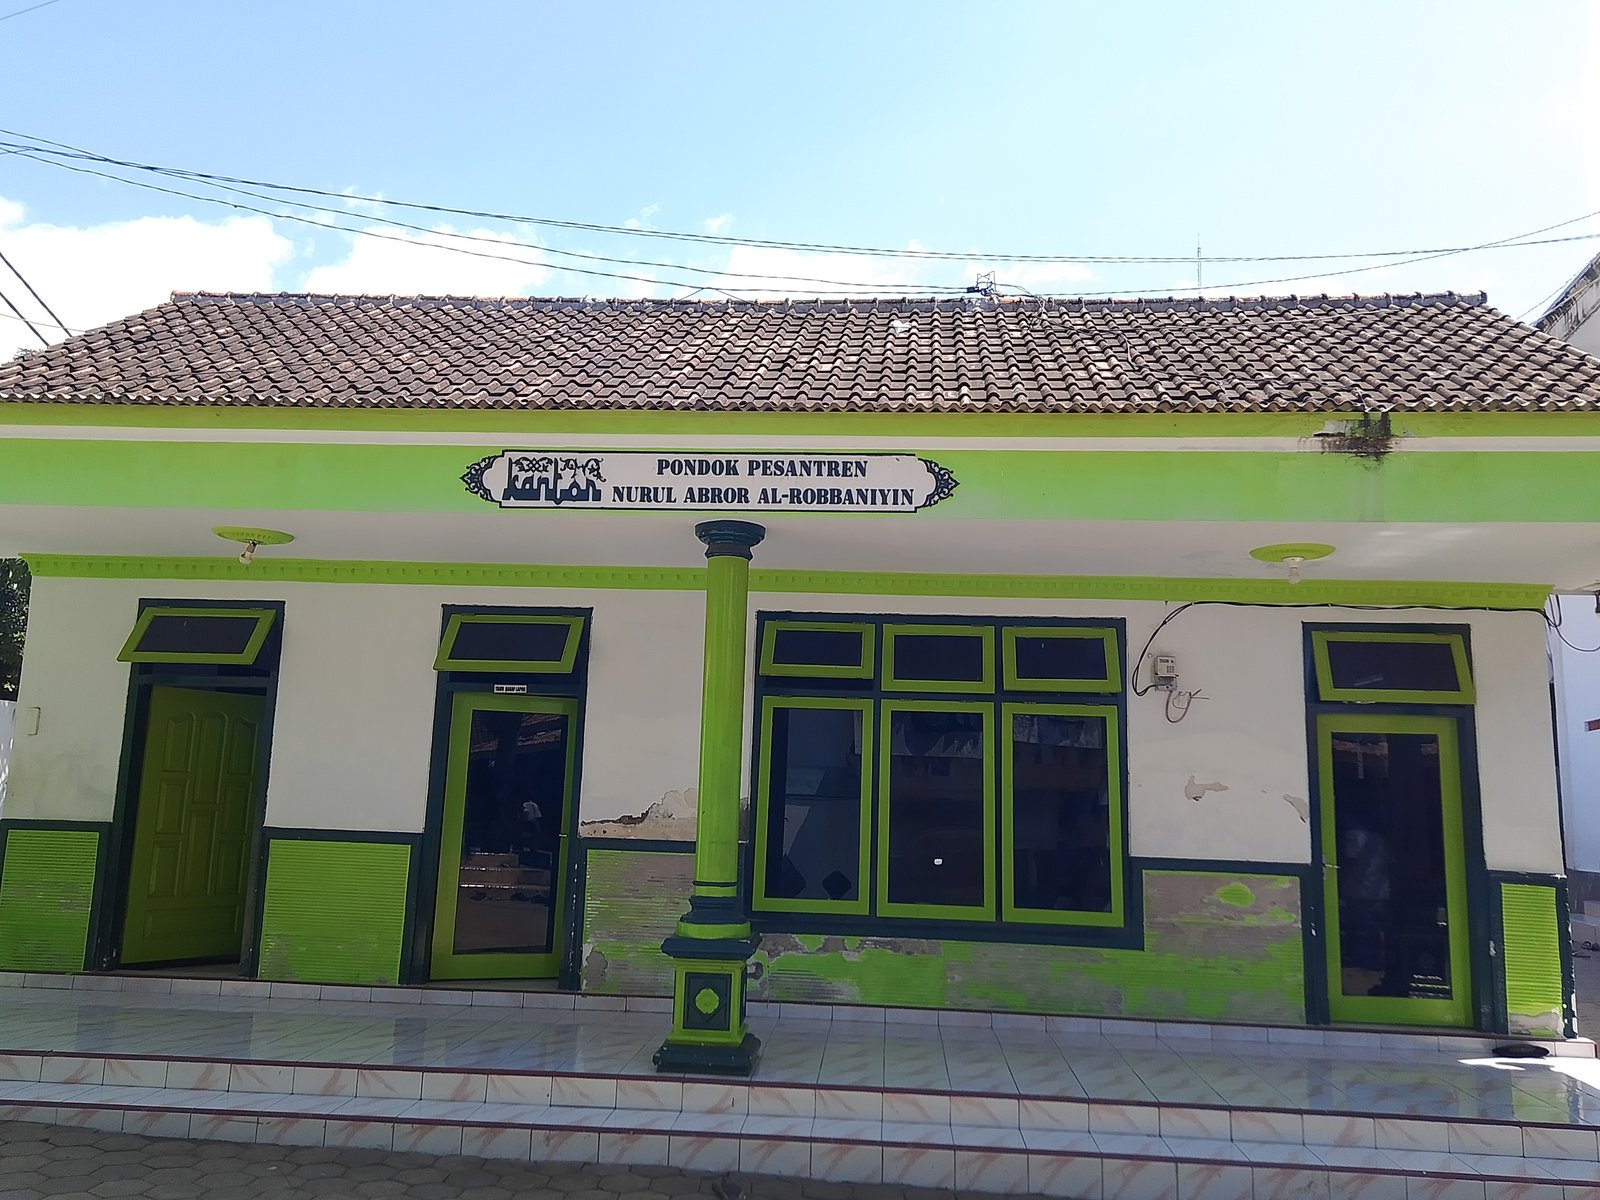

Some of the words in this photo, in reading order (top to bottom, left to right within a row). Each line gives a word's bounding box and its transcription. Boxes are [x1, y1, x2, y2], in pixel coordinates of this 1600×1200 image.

[656, 458, 739, 476] PONDOK
[747, 459, 868, 478] PESANTREN
[612, 486, 677, 503] NURUL
[683, 486, 750, 504] ABROR
[757, 487, 914, 506] AL-ROBBANIYIN
